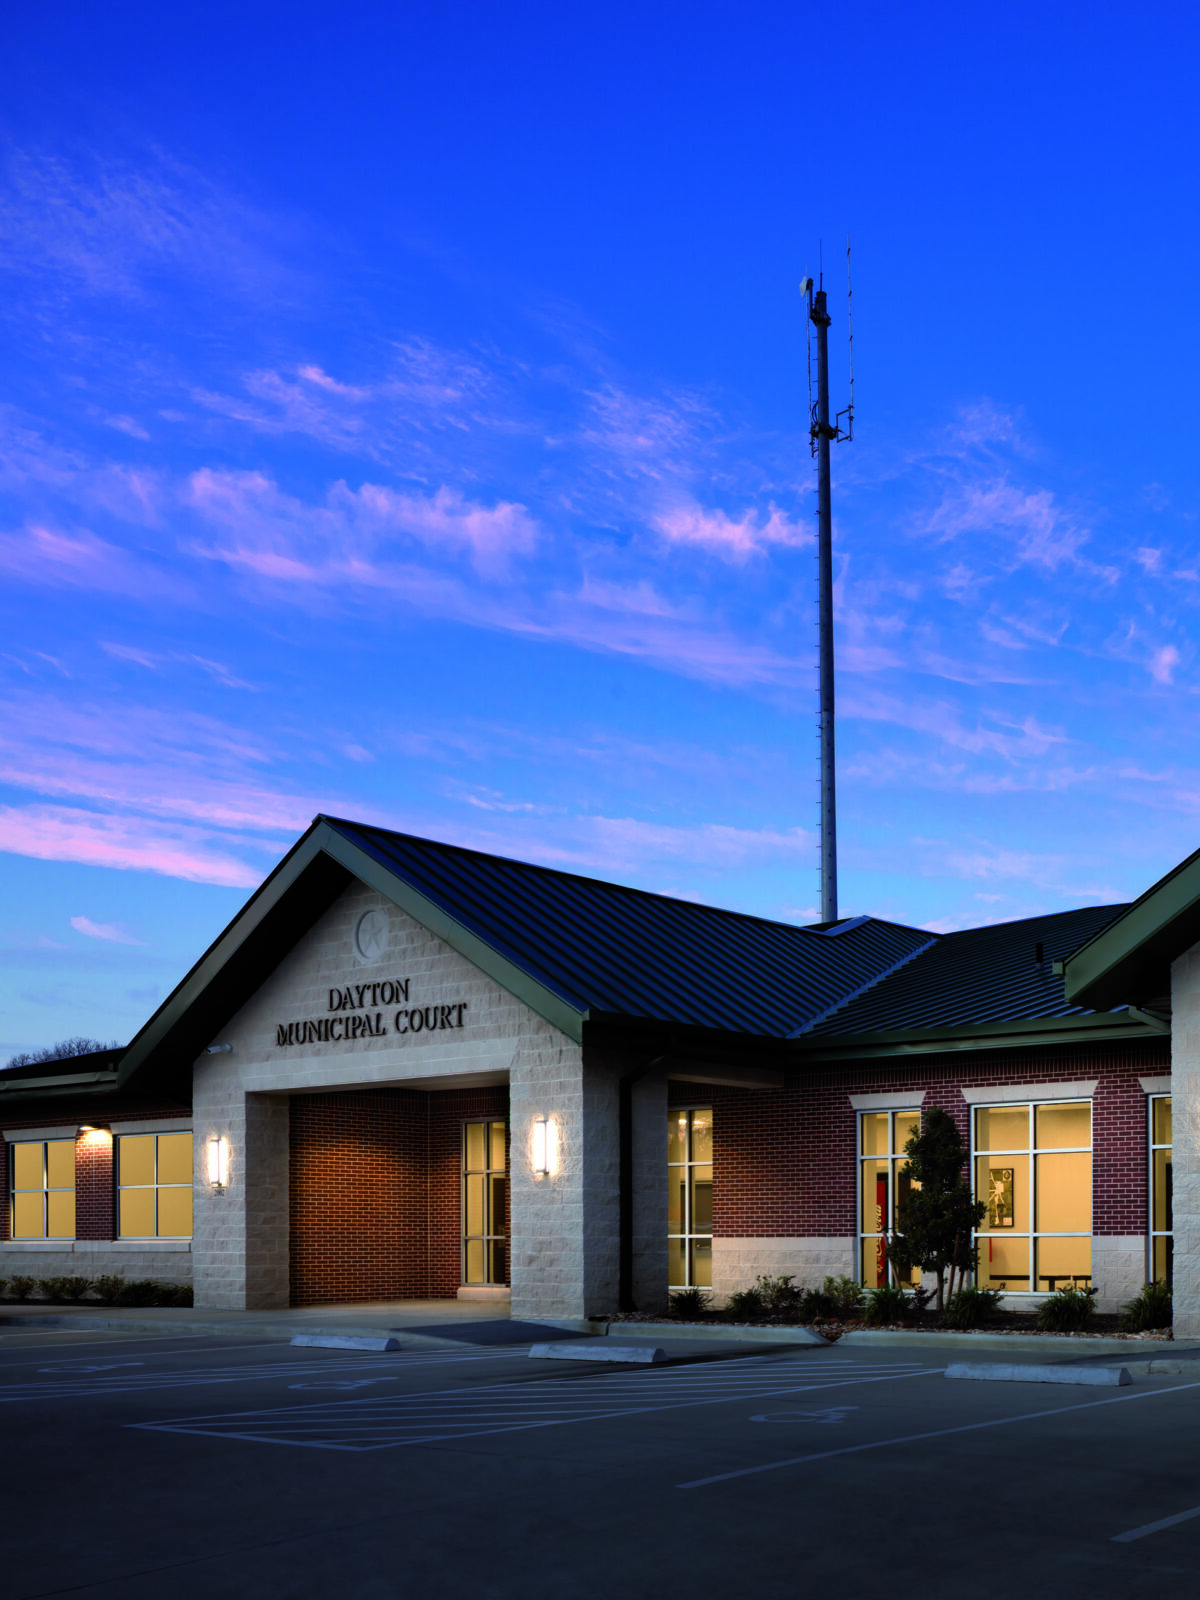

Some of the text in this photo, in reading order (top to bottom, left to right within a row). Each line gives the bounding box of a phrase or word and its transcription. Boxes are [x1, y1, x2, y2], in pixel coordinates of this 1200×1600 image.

[327, 978, 411, 1012] DAYTON
[276, 1002, 468, 1047] MUNICIPAL COURT
